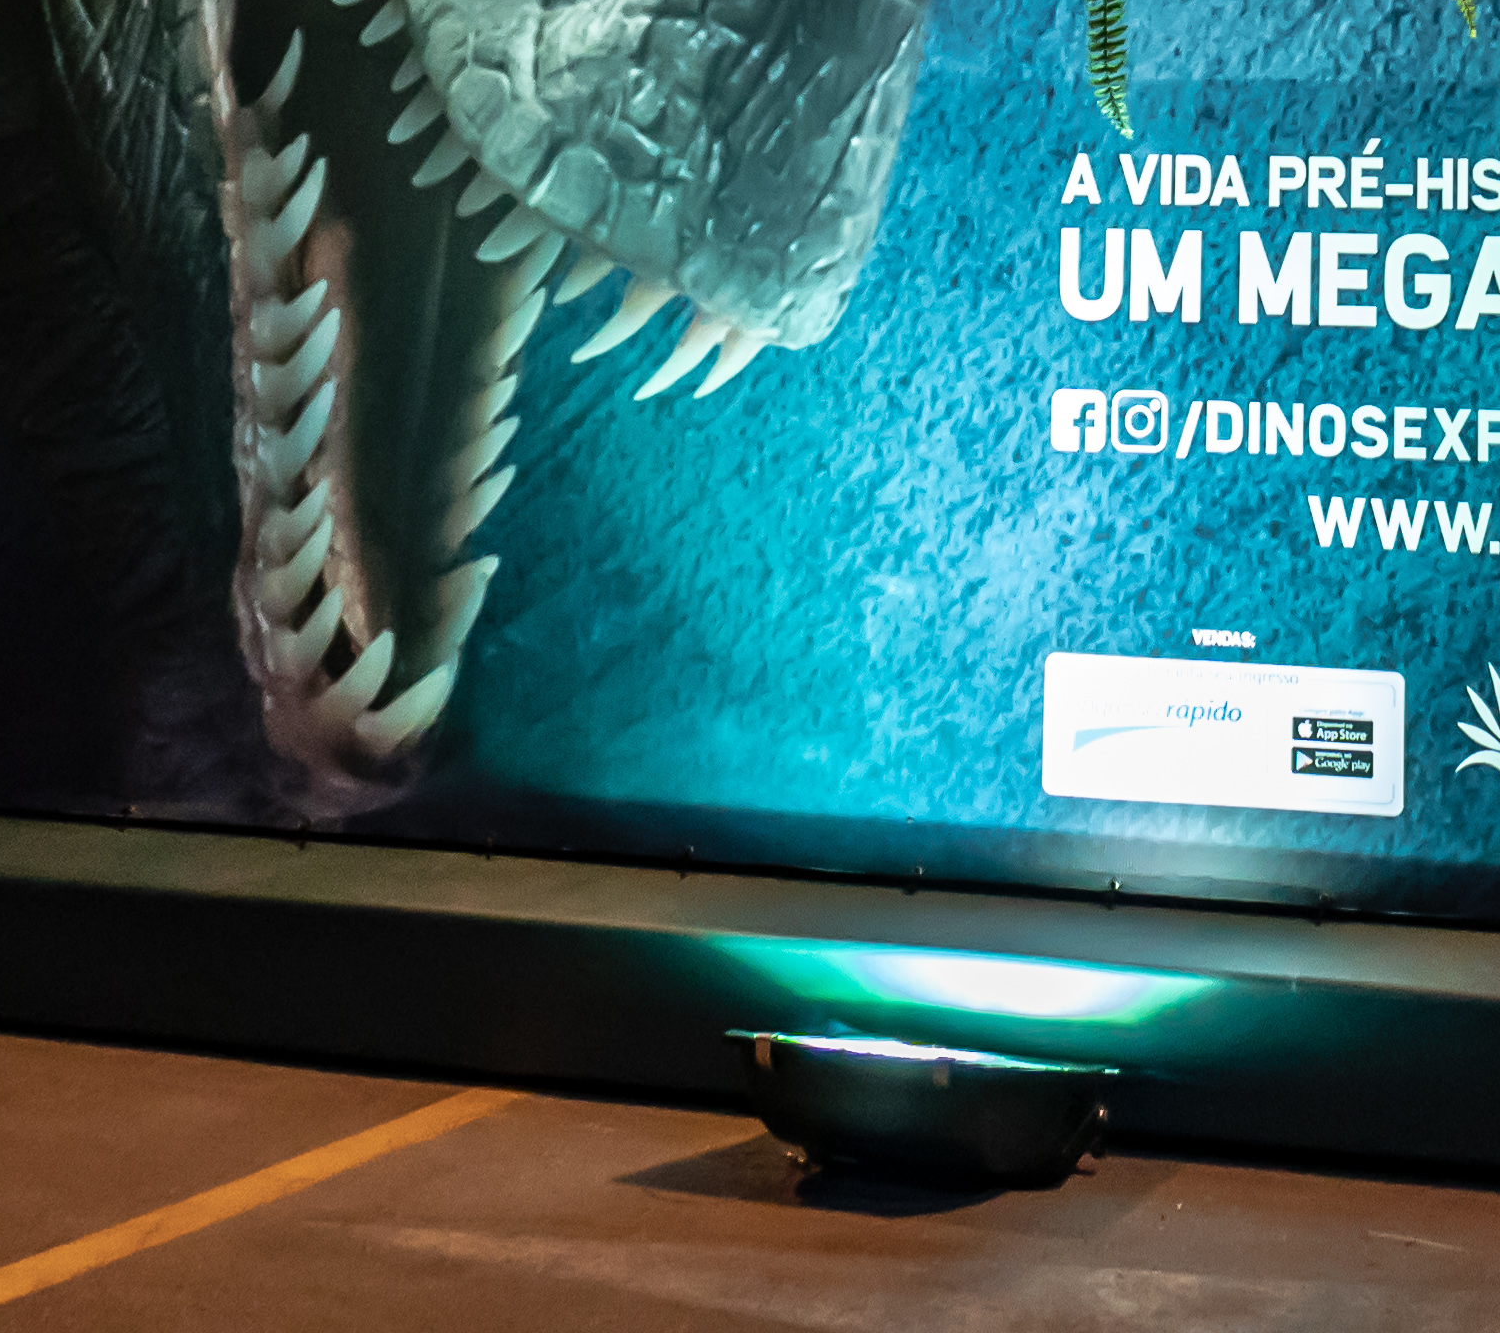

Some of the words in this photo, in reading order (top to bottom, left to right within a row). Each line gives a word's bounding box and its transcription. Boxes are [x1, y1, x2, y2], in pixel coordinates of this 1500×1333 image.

[1061, 152, 1102, 205] A
[1119, 153, 1250, 208] VIDA
[1058, 226, 1203, 324] UM
[1192, 628, 1256, 648] VENDAS:
[1316, 727, 1338, 742] App
[1339, 728, 1367, 742] Store
[1315, 757, 1349, 773] Google
[1352, 760, 1371, 774] play
